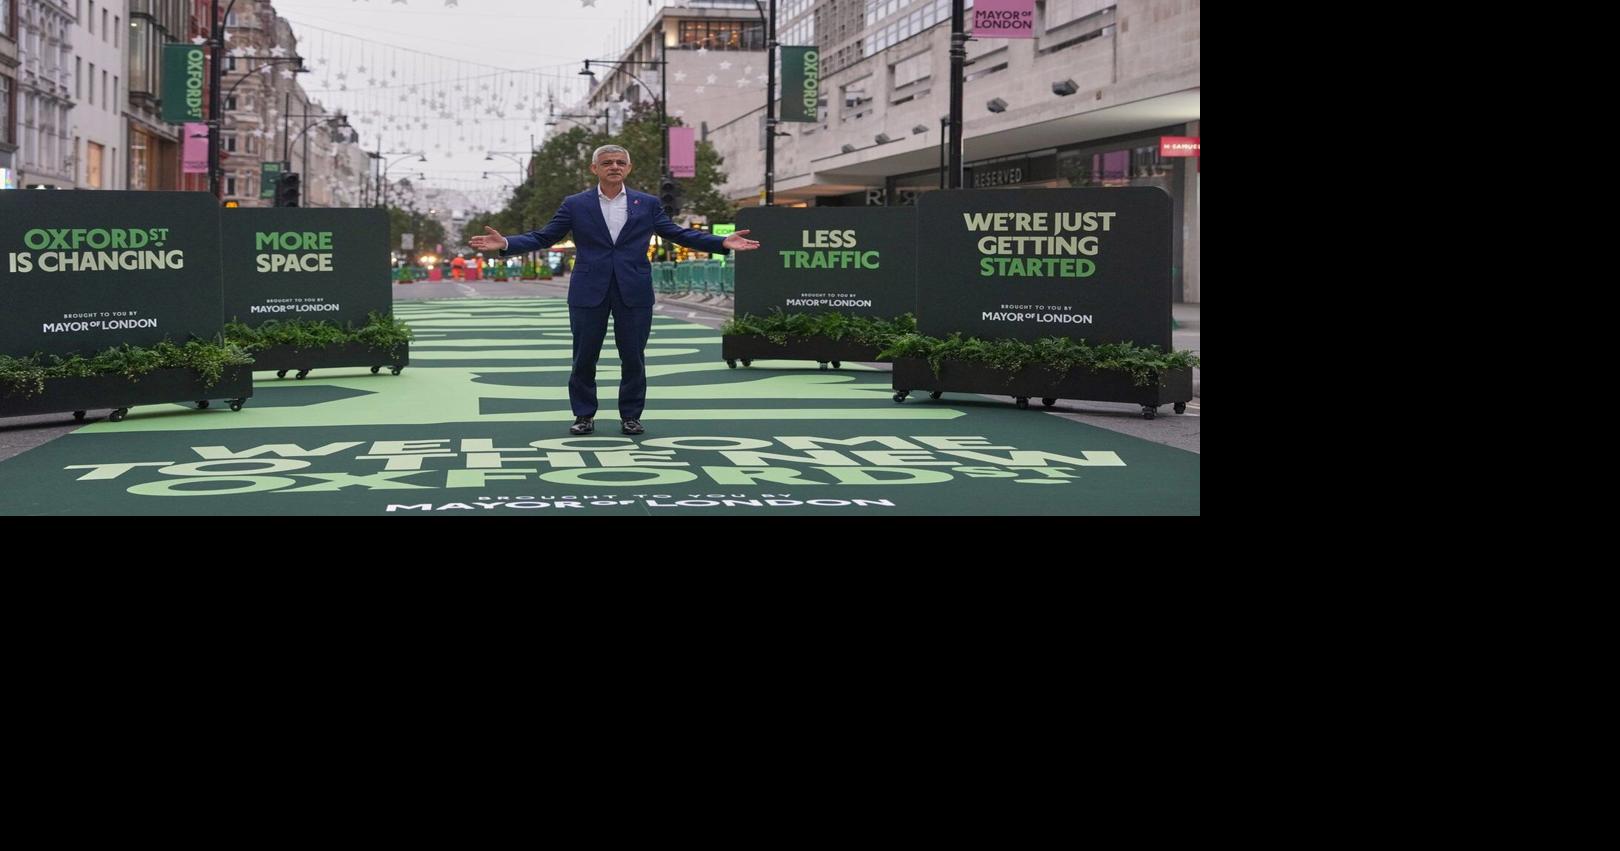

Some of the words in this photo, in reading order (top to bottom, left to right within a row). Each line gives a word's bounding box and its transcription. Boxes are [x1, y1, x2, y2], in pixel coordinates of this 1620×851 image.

[975, 10, 1019, 20] MAYOR
[975, 20, 1032, 29] LONDON
[187, 50, 204, 108] OXFORD
[803, 51, 818, 107] OXFORD
[975, 168, 1022, 187] RESERVED
[963, 212, 1048, 231] WE’RE
[1054, 211, 1116, 236] JUST
[24, 228, 149, 250] OXFORD
[256, 231, 333, 250] MORE
[802, 229, 857, 248] LESS
[977, 236, 1099, 256] GETTING
[9, 252, 33, 273] IS
[38, 249, 184, 272] CHANGING
[256, 253, 333, 272] SPACE
[779, 250, 880, 269] TRAFFIC
[980, 257, 1096, 278] STARTED
[251, 305, 286, 313] MAYOR
[296, 303, 340, 312] LONDON
[786, 299, 819, 307] MAYOR
[829, 299, 872, 307] LONDON
[43, 321, 89, 333] MAYOR
[102, 318, 157, 330] LONDON
[982, 311, 1024, 322] MAYOR
[1036, 313, 1093, 324] LONDON
[190, 436, 1017, 459] WELCOME
[63, 458, 311, 480] TO
[355, 450, 690, 470] THE
[718, 450, 1127, 466] NEW
[126, 466, 954, 496] OXFORD
[386, 501, 584, 511] MAYOR
[646, 499, 895, 507] LONDON
